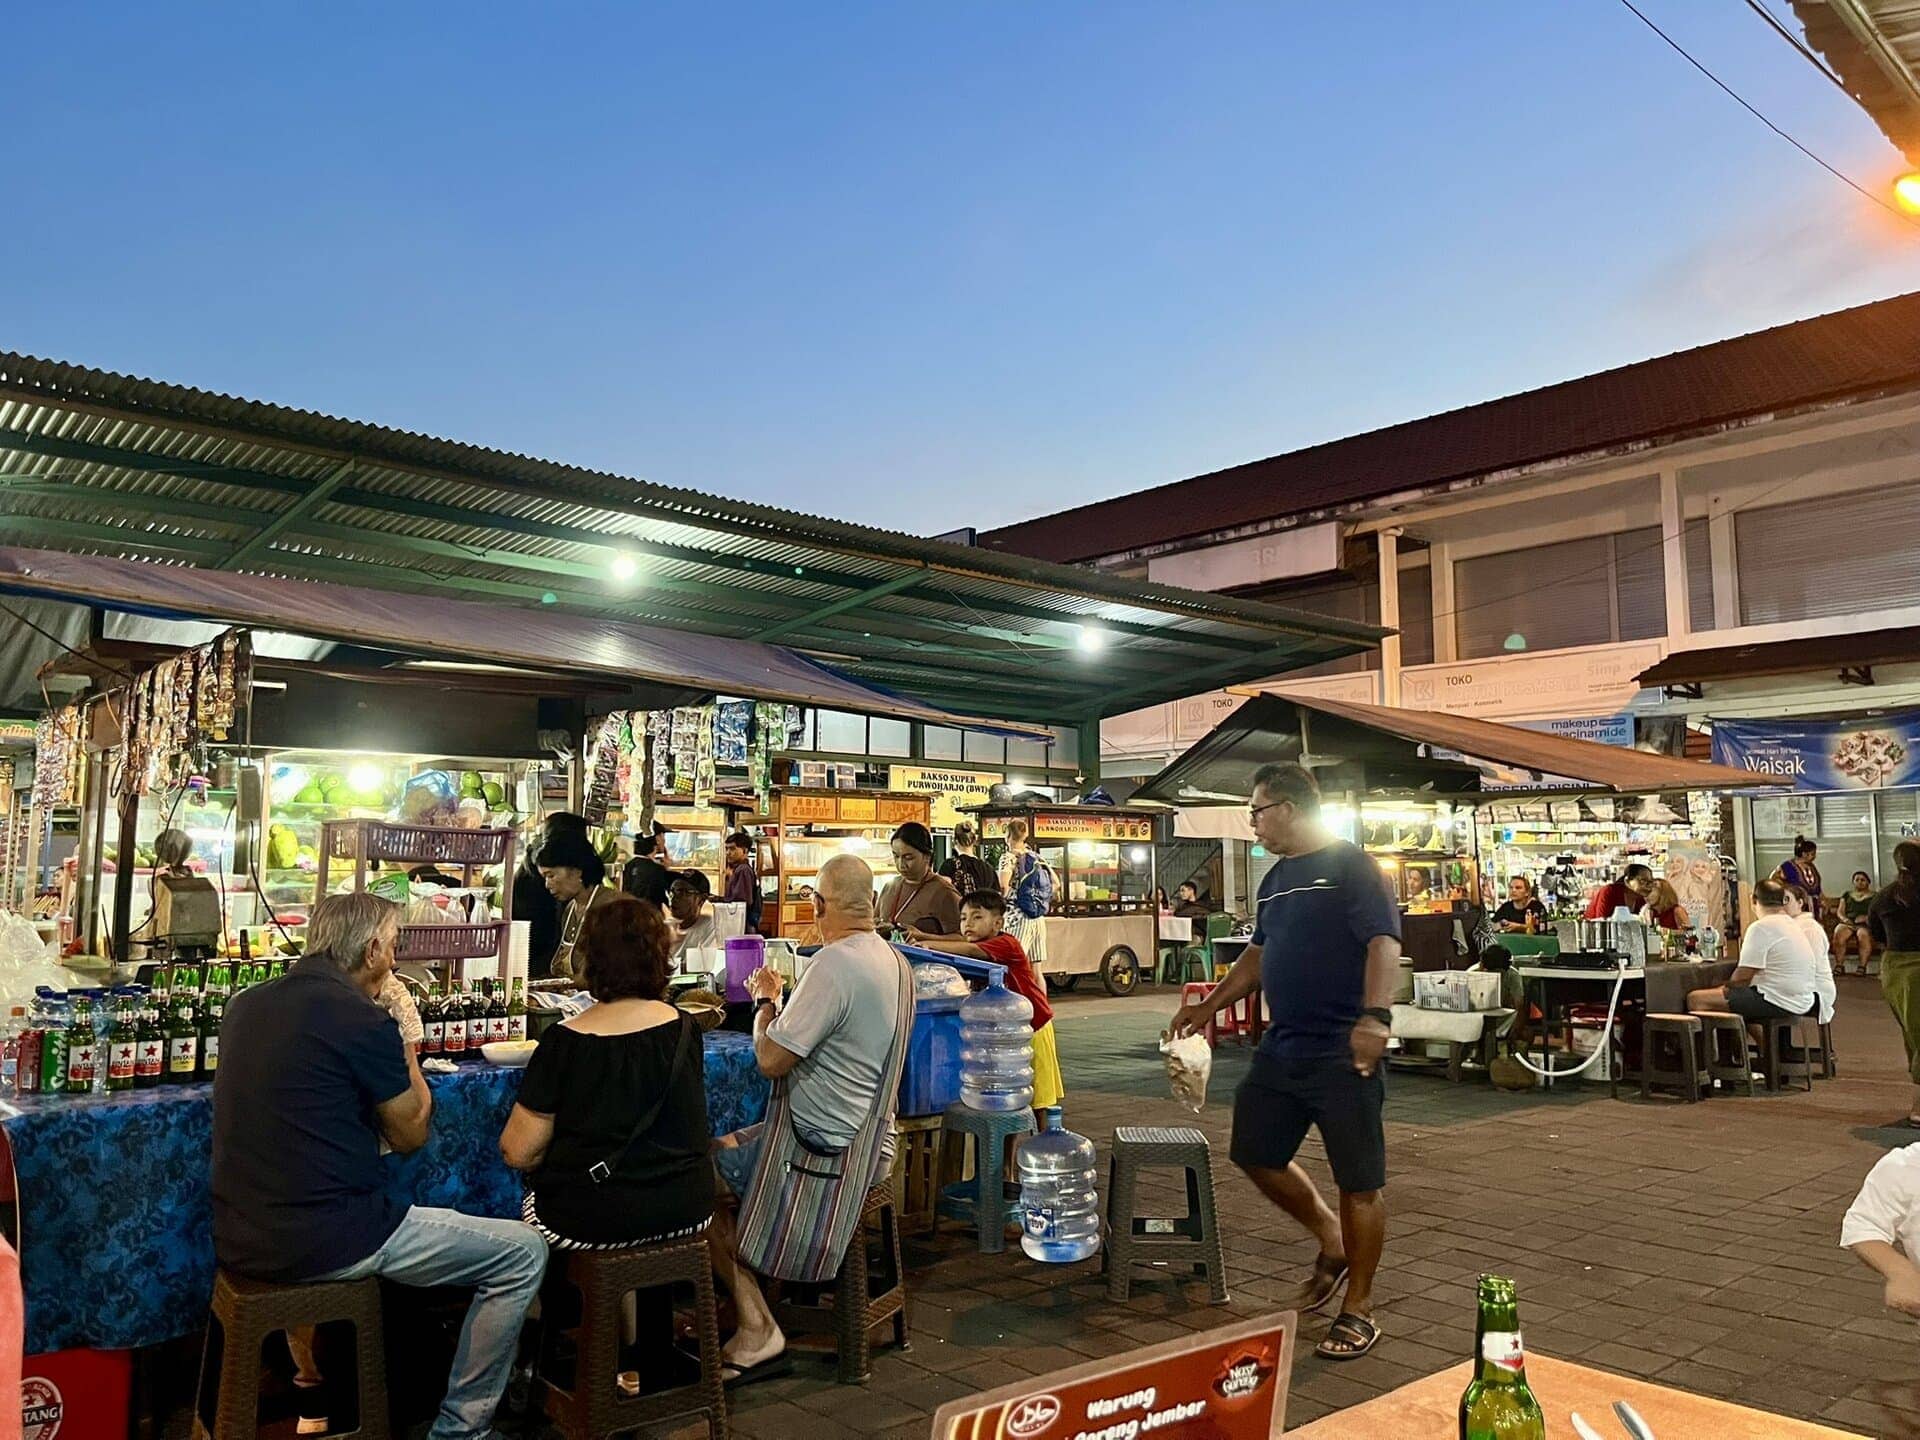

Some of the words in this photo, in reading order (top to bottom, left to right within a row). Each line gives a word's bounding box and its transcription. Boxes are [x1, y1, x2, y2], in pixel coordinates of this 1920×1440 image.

[1446, 674, 1473, 687] TOKO
[1212, 698, 1233, 709] TOKO
[1551, 718, 1598, 729] makeup
[1553, 727, 1627, 739] iacinamide
[1742, 755, 1806, 775] Waisak
[921, 772, 949, 781] BAKSO
[950, 775, 976, 784] SUPER
[907, 780, 965, 792] PURWOHARJO
[1087, 1386, 1156, 1419] Warung
[1141, 1400, 1207, 1431] Jember
